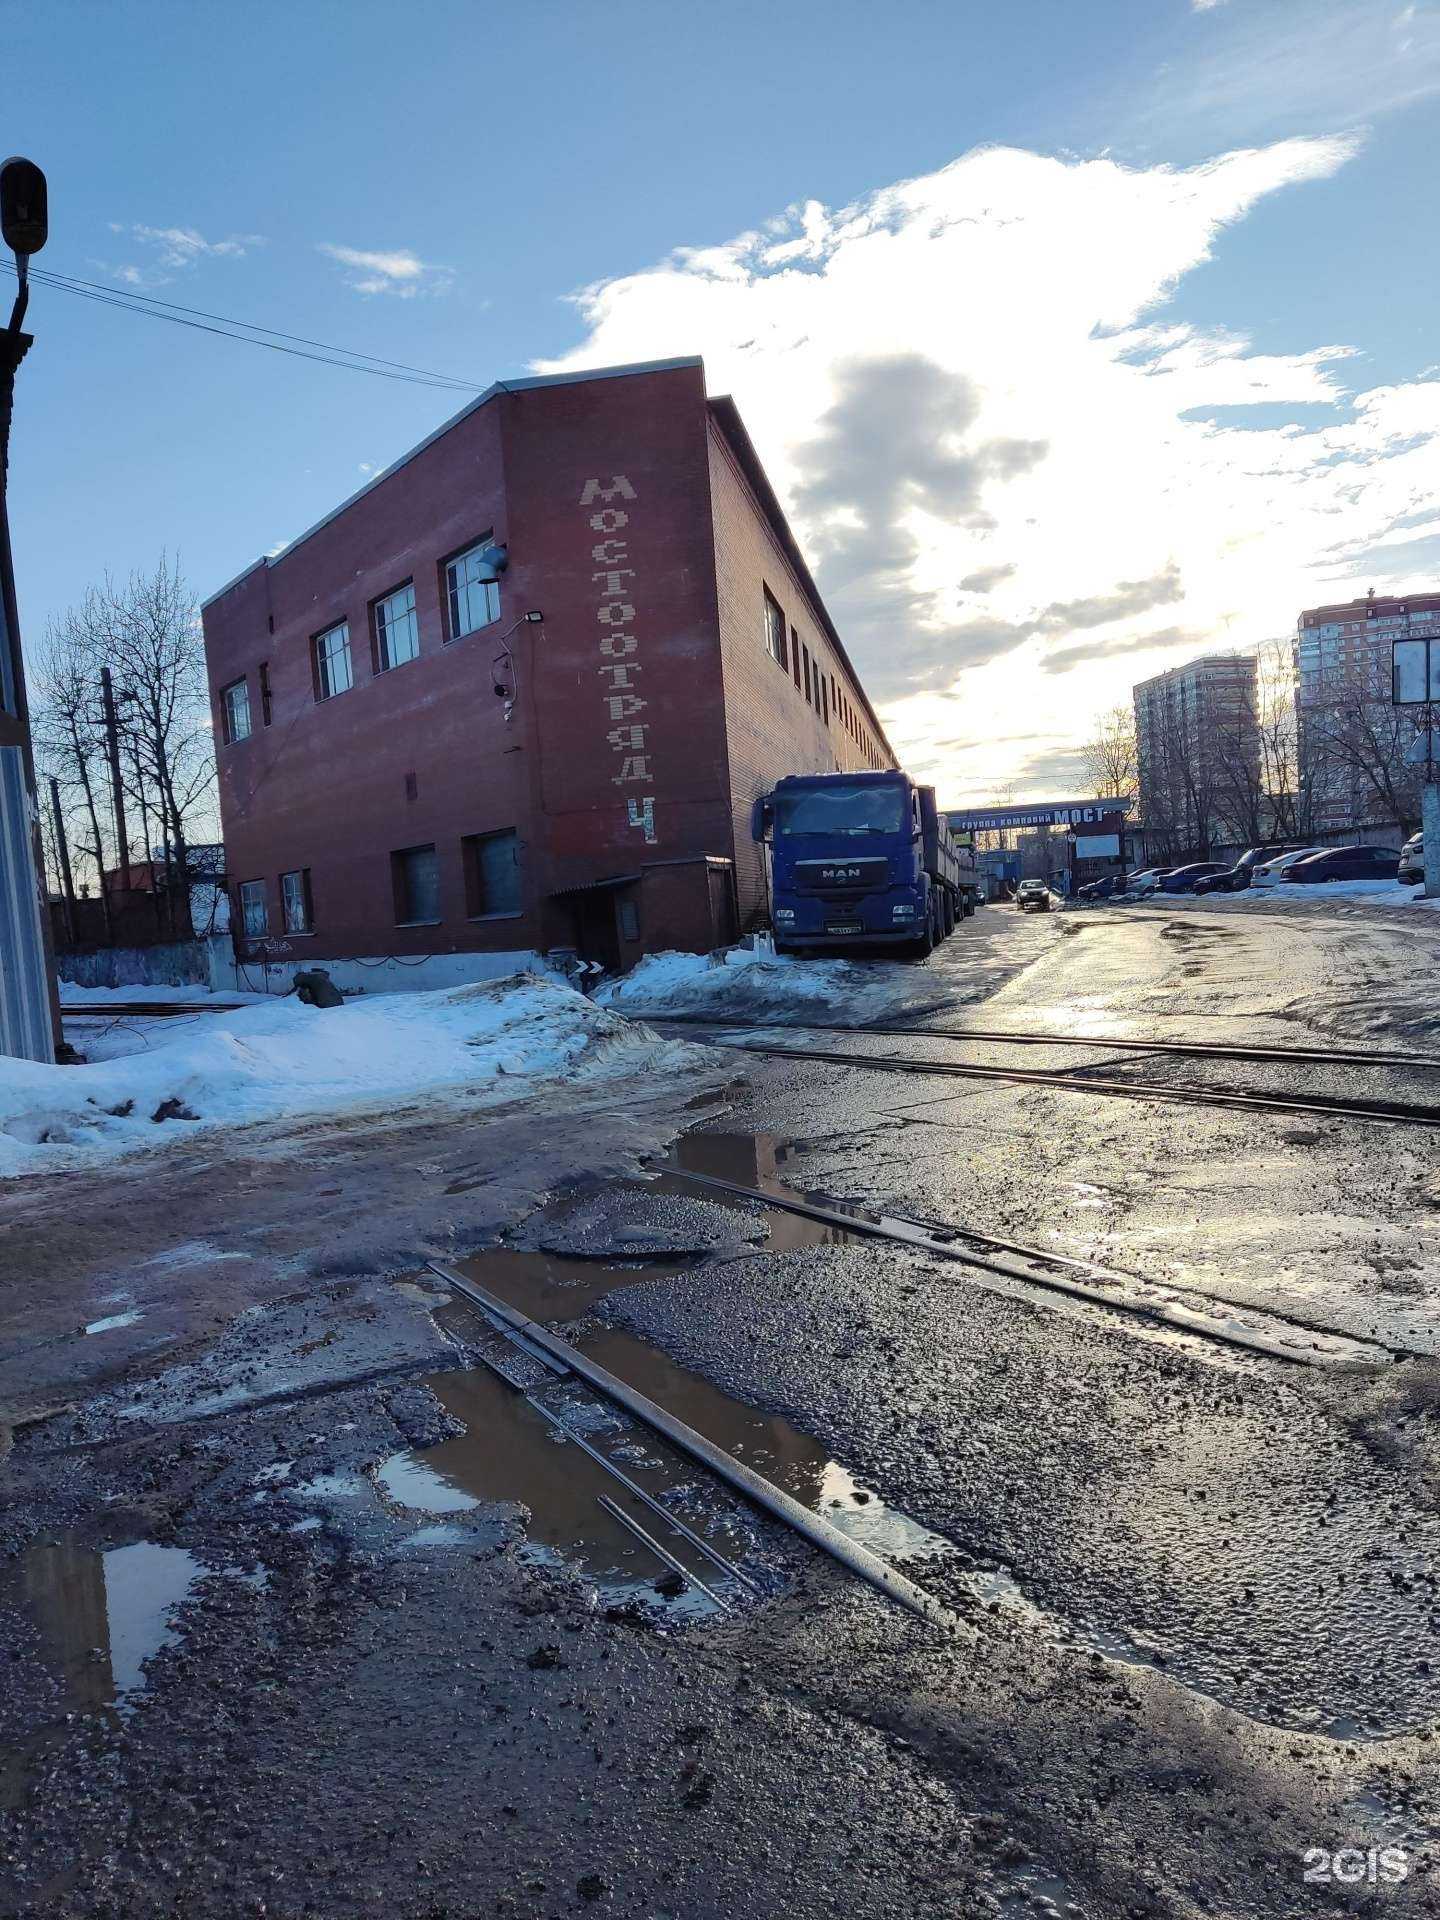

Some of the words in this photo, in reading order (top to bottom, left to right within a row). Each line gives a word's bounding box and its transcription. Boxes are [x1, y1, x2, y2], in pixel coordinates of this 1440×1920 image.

[579, 475, 653, 784] МОСТООТРЯД
[962, 819, 996, 829] группа
[1000, 814, 1051, 826] компаний
[1055, 807, 1105, 824] МОСТ
[822, 869, 860, 877] MAN
